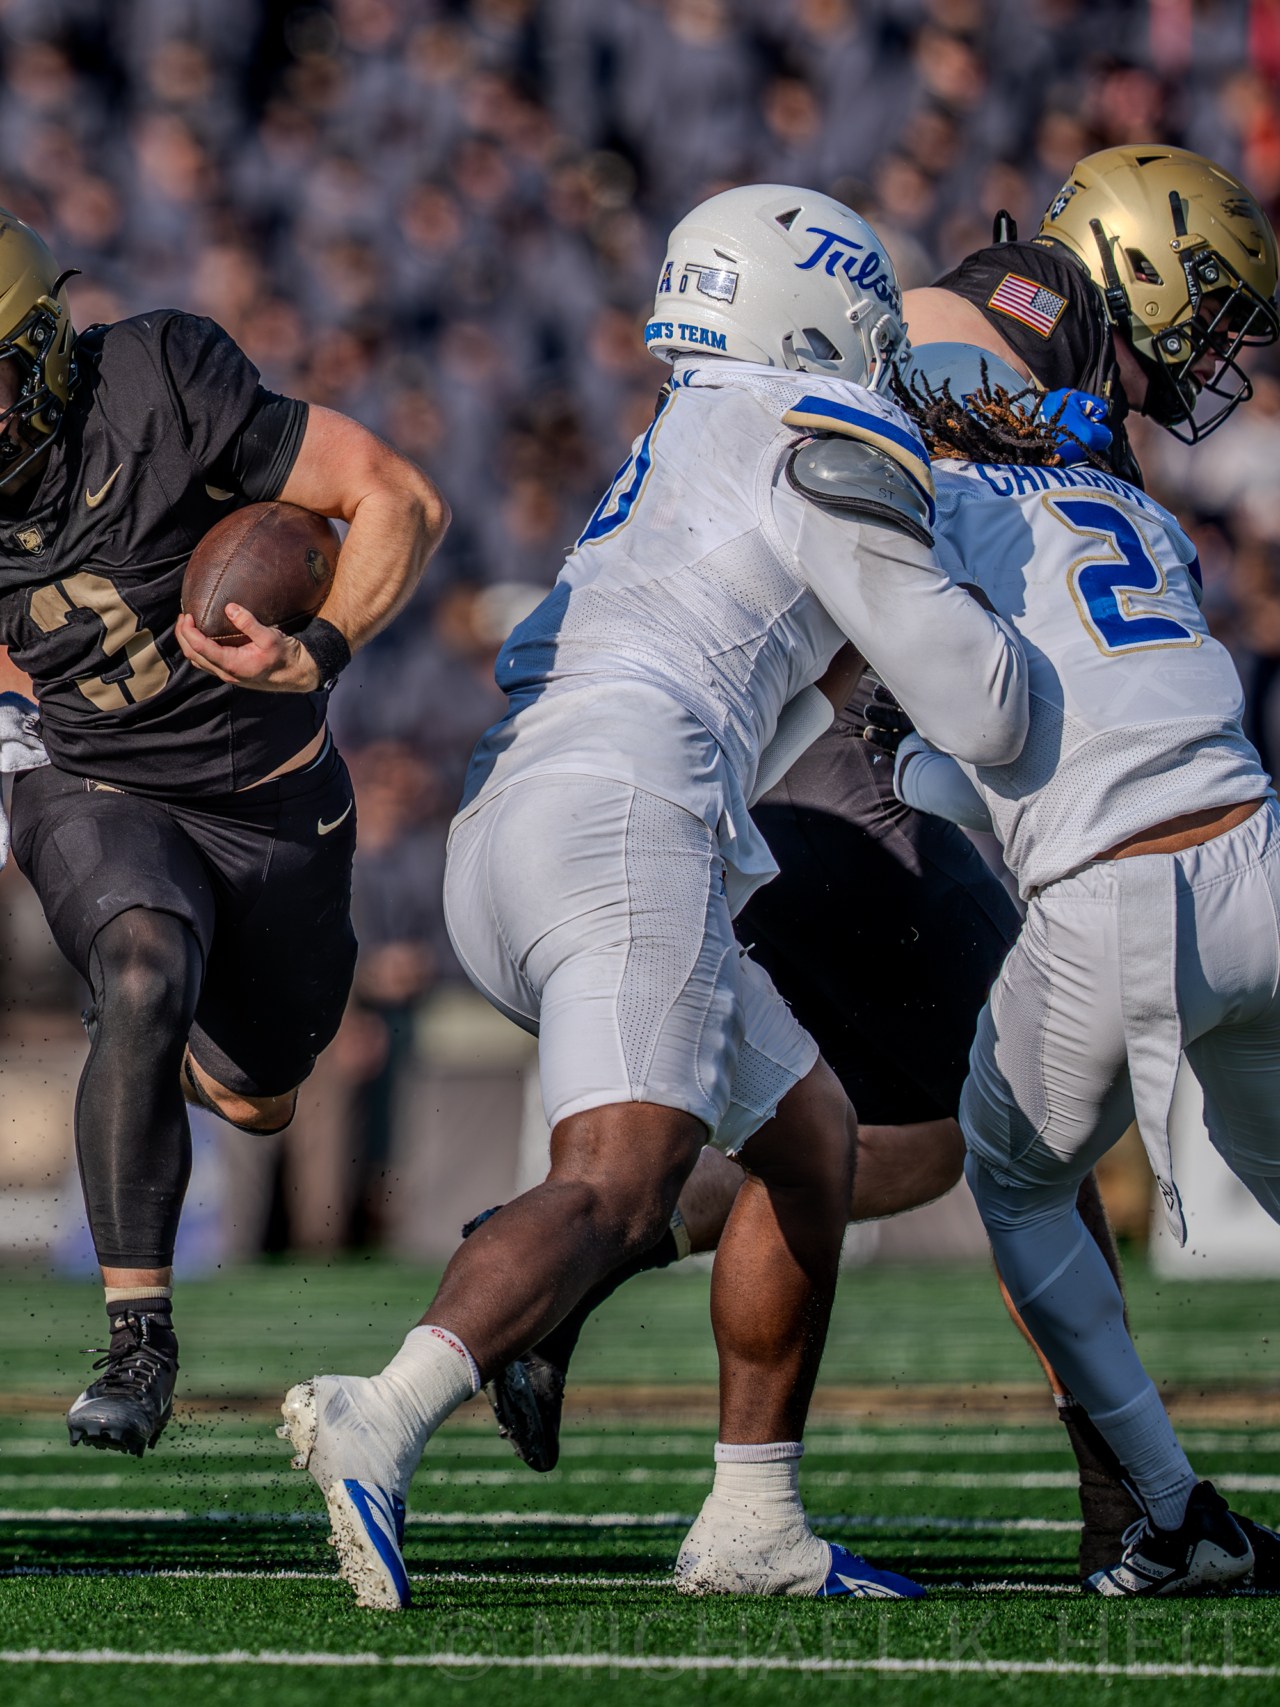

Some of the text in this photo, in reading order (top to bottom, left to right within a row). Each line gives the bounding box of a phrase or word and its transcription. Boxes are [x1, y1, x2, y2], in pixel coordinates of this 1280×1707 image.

[677, 323, 728, 352] TEAM
[878, 487, 896, 501] ST
[1040, 490, 1204, 658] 2
